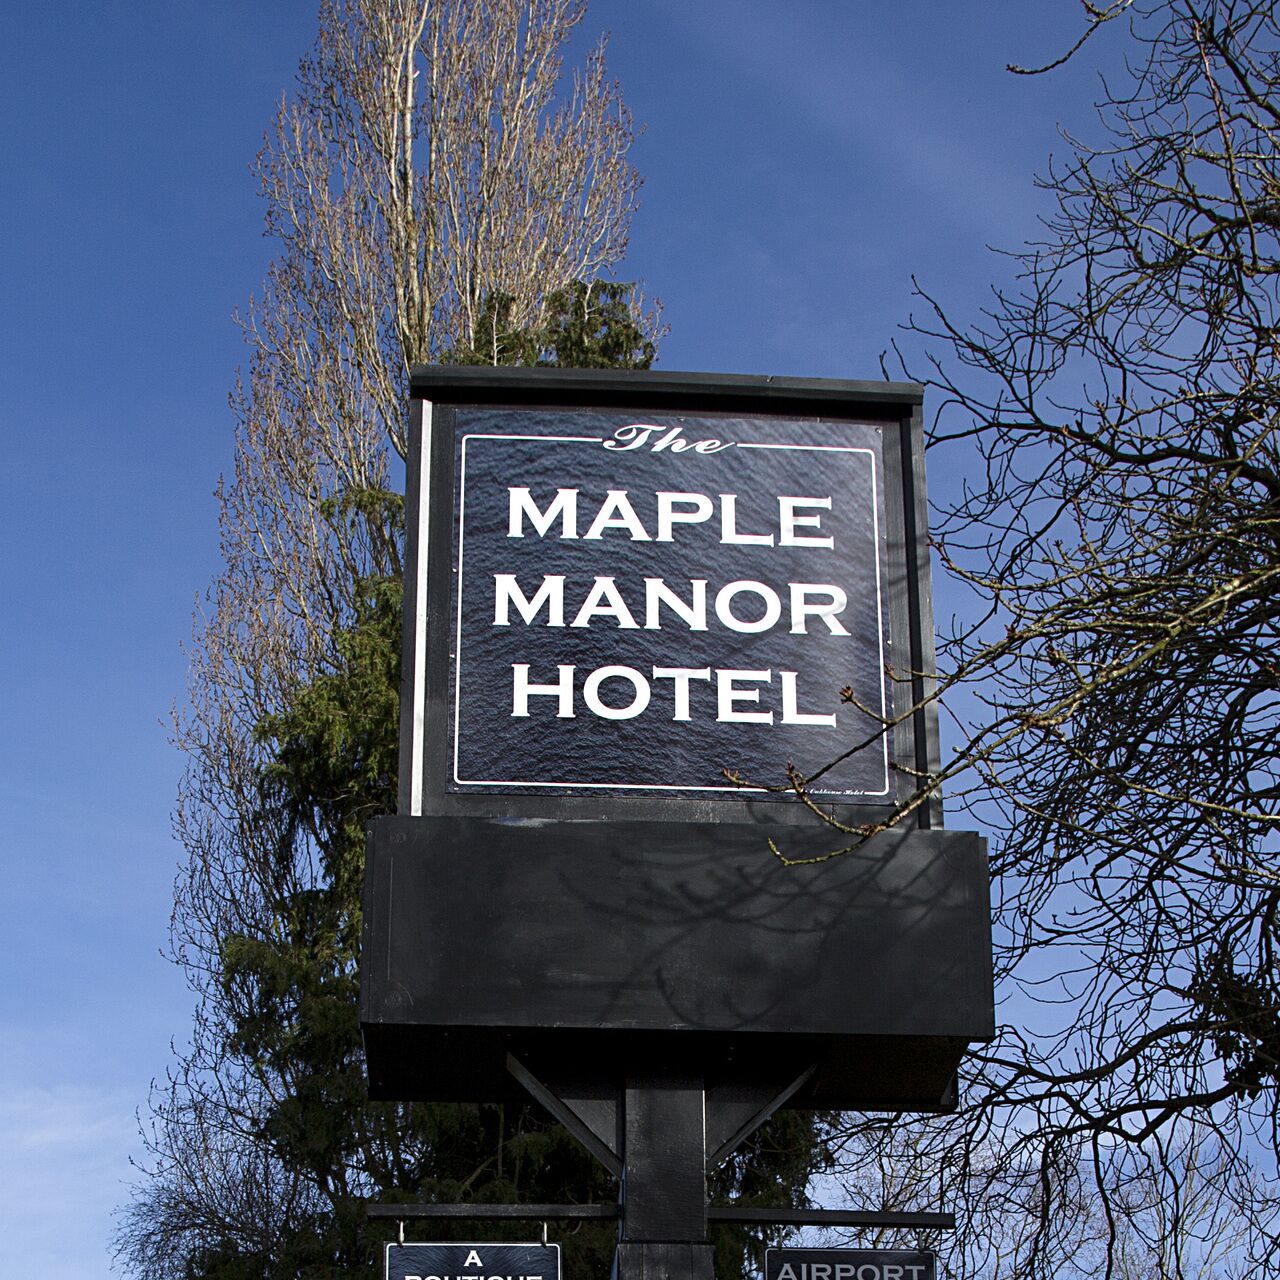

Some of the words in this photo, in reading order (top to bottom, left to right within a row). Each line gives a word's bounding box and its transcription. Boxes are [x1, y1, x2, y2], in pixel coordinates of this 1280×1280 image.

[602, 424, 736, 455] The
[507, 487, 835, 550] MAPLE
[493, 574, 852, 637] MANOR
[511, 664, 837, 729] HOTEL
[464, 1249, 484, 1267] A
